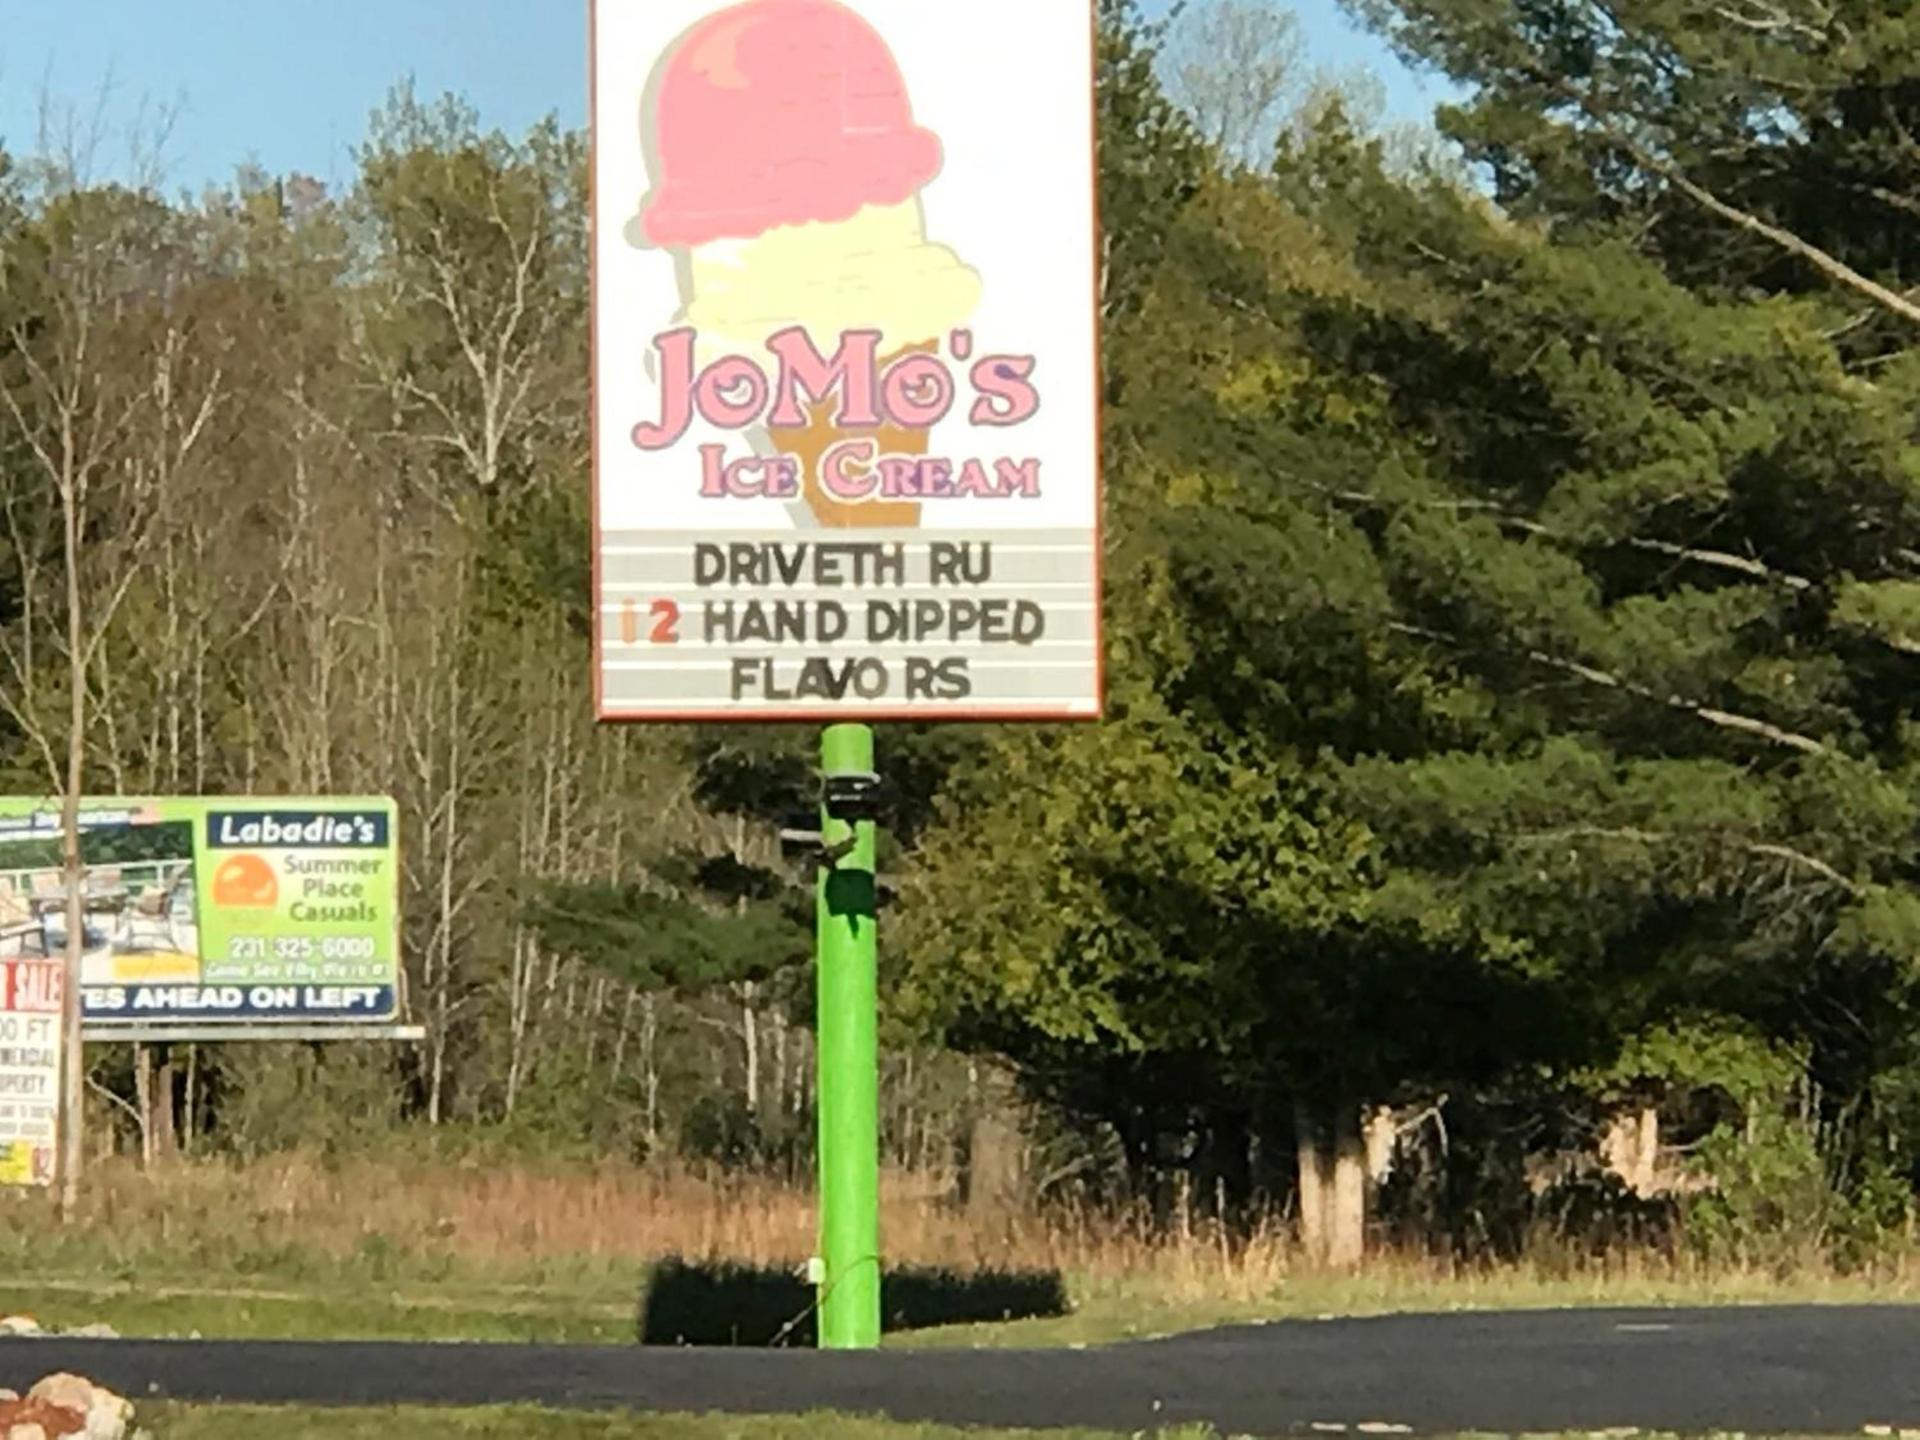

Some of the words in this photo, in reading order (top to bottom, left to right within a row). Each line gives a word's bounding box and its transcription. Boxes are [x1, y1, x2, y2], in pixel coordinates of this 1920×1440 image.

[704, 599, 848, 643] HAND
[867, 599, 1045, 645] DIPPED
[220, 815, 375, 843] Labadie's
[284, 854, 383, 874] Summer
[303, 878, 364, 898] Place
[289, 901, 378, 922] Casuals
[133, 987, 243, 1008] AHEAD
[249, 986, 298, 1008] ON
[304, 986, 381, 1008] LEFT
